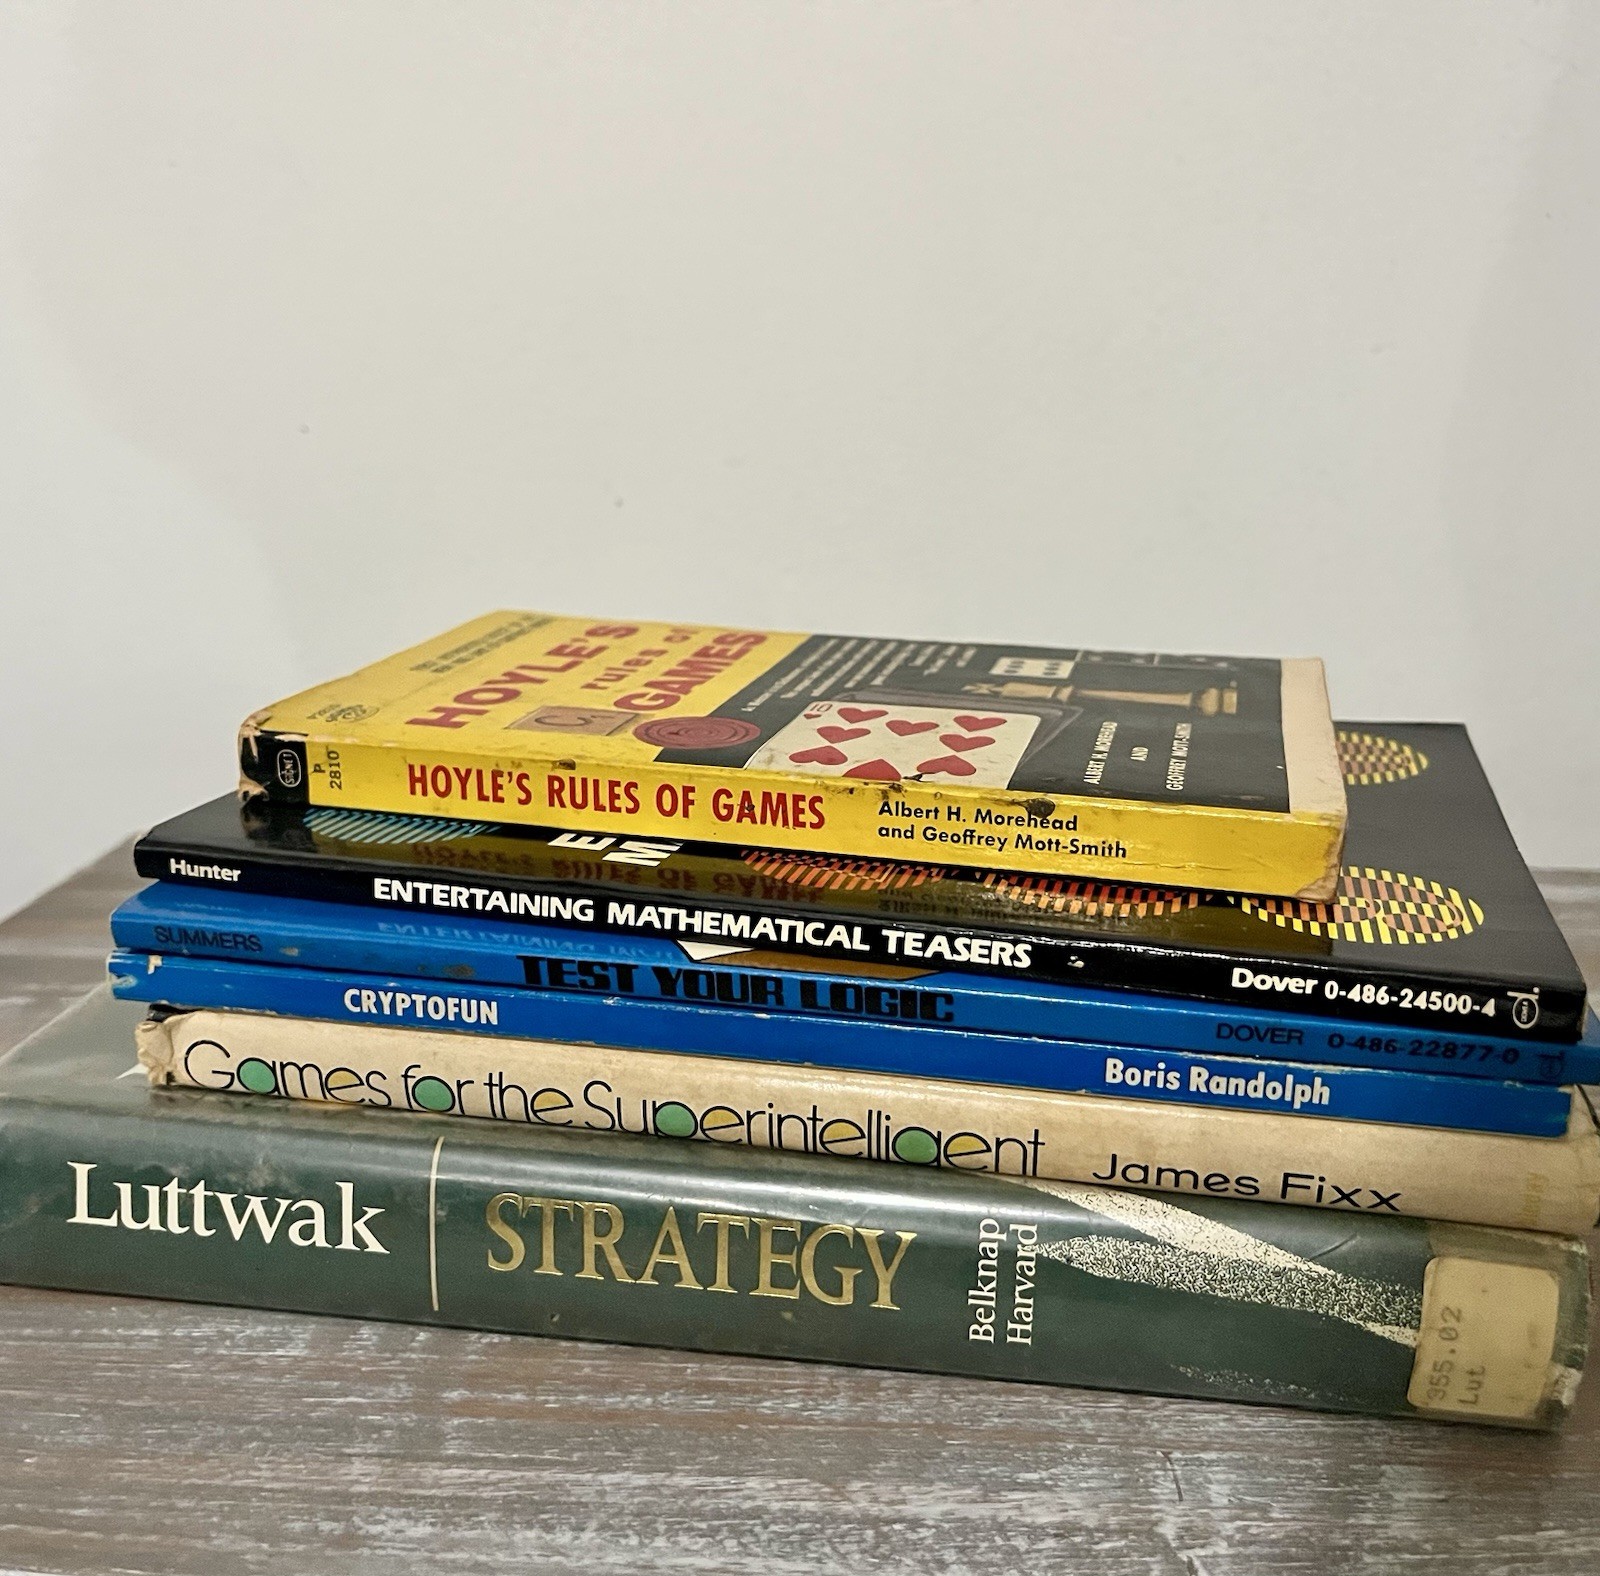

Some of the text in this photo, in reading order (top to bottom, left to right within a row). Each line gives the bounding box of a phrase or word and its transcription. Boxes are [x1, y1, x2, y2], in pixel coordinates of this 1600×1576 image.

[405, 625, 639, 728] HOYLE'S
[581, 647, 669, 690] rules
[613, 632, 767, 711] GAMES
[313, 763, 326, 774] P
[328, 750, 343, 790] 2810
[1083, 760, 1105, 784] ALBERT
[1130, 746, 1149, 761] AND
[1165, 758, 1187, 790] GEOFFREY
[407, 763, 826, 831] HOYLE'S RULES OF GAMES
[878, 800, 1079, 832] Albert H. Morehead
[877, 823, 1128, 859] and Geoffrey Mott-Smith
[169, 857, 242, 883] Hunter
[154, 924, 263, 953] SUMMERS
[373, 877, 595, 922] ENTERTAINING
[607, 901, 870, 952] MATHEMATICAL
[882, 929, 1033, 969] TEASERS
[343, 987, 499, 1026] CRYPTOFUN
[516, 955, 954, 1022] TEST YOUR LOGIC
[1231, 967, 1496, 1017] Dover 0-486-24500-4
[1216, 1022, 1304, 1045] DOVER
[1328, 1033, 1520, 1066] 0-486-22877-0
[184, 1039, 1046, 1178] Games for the Superintelligent
[1105, 1058, 1330, 1109] Boris Randolph
[1092, 1153, 1402, 1212] James Fixx
[66, 1161, 391, 1255] Luttwak
[485, 1191, 918, 1311] STRATEGY
[968, 1216, 1007, 1345] Belknap
[1006, 1223, 1039, 1347] Harvard
[1425, 1305, 1463, 1403] 355.02
[1457, 1365, 1486, 1407] Lut
